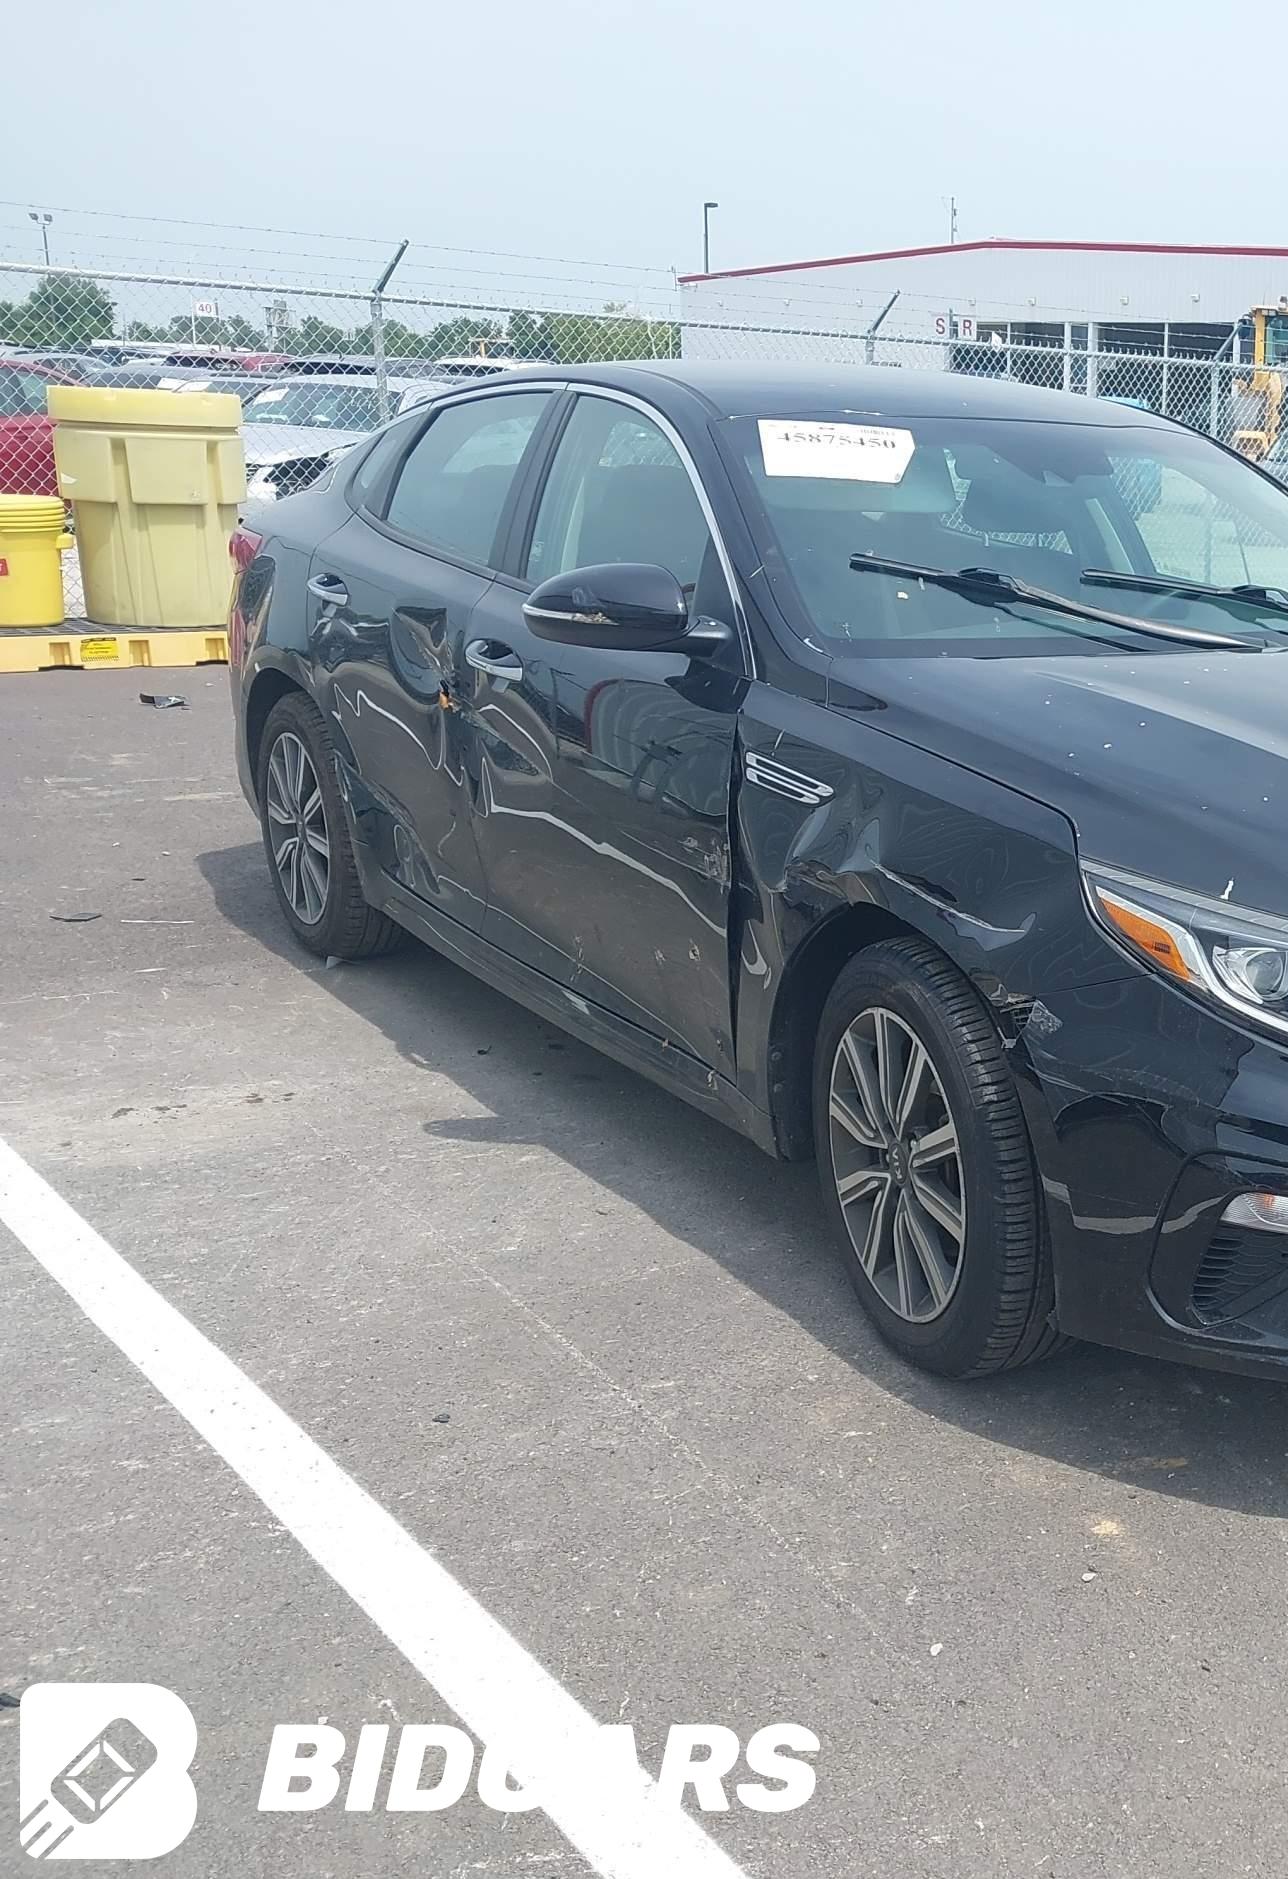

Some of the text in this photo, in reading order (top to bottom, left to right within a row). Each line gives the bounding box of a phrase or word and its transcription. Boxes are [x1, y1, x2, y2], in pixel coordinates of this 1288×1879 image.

[198, 303, 213, 314] 40
[935, 317, 946, 335] S
[962, 319, 973, 336] R
[892, 1147, 903, 1179] KIA
